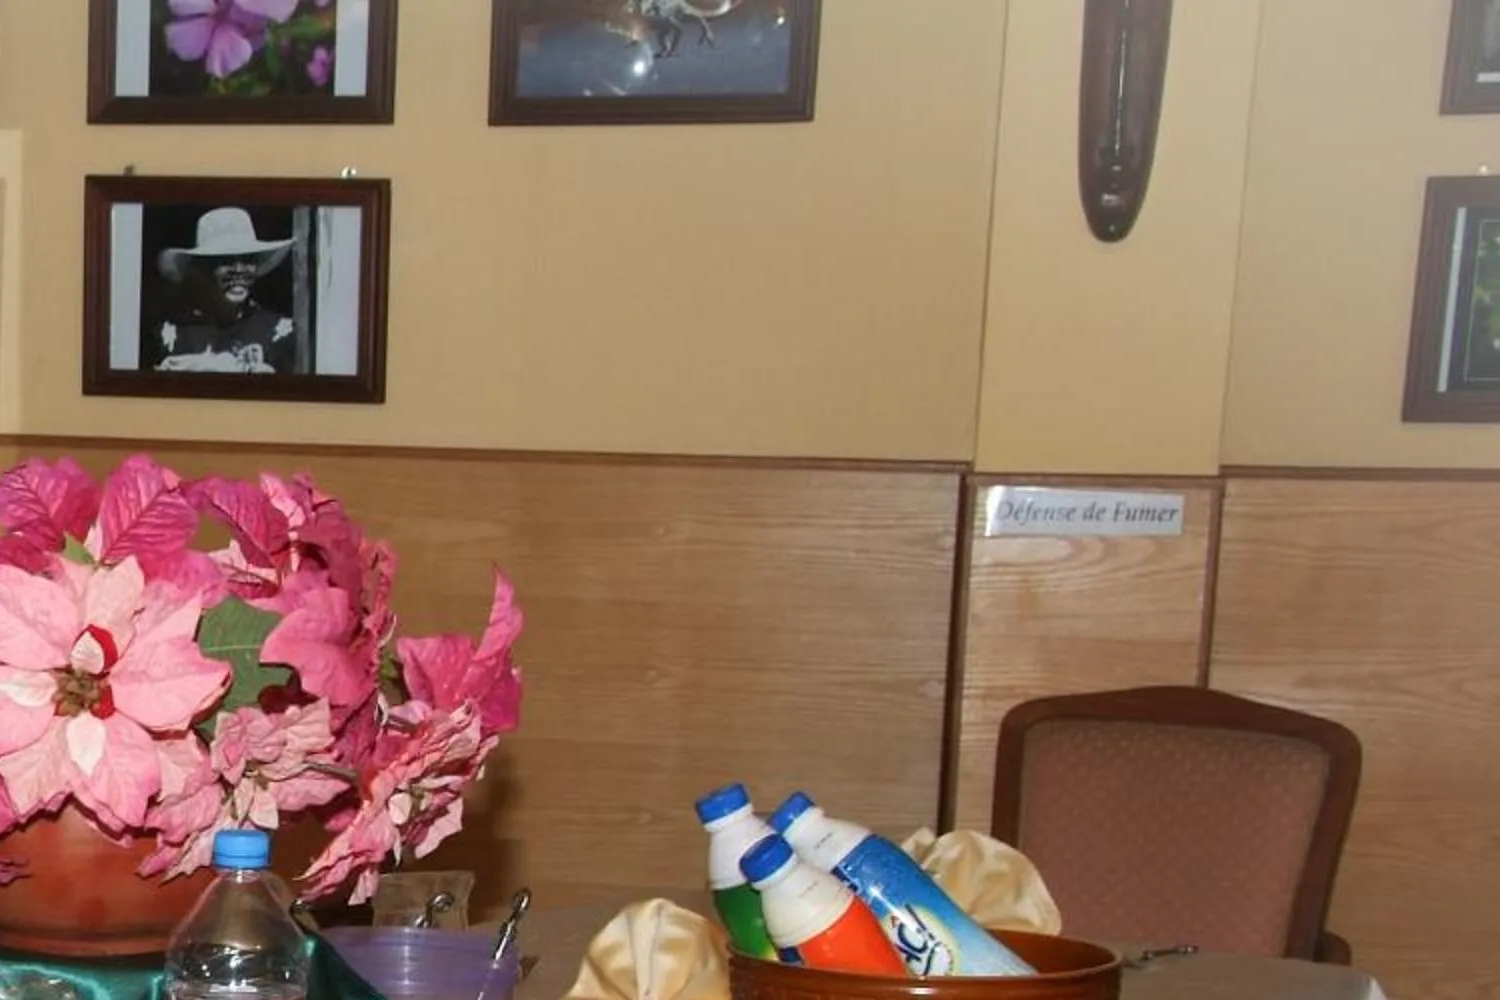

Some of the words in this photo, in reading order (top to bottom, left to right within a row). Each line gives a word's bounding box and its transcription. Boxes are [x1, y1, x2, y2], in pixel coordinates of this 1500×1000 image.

[997, 500, 1077, 525] Défense
[1082, 501, 1106, 522] de
[1113, 501, 1179, 523] Fumer
